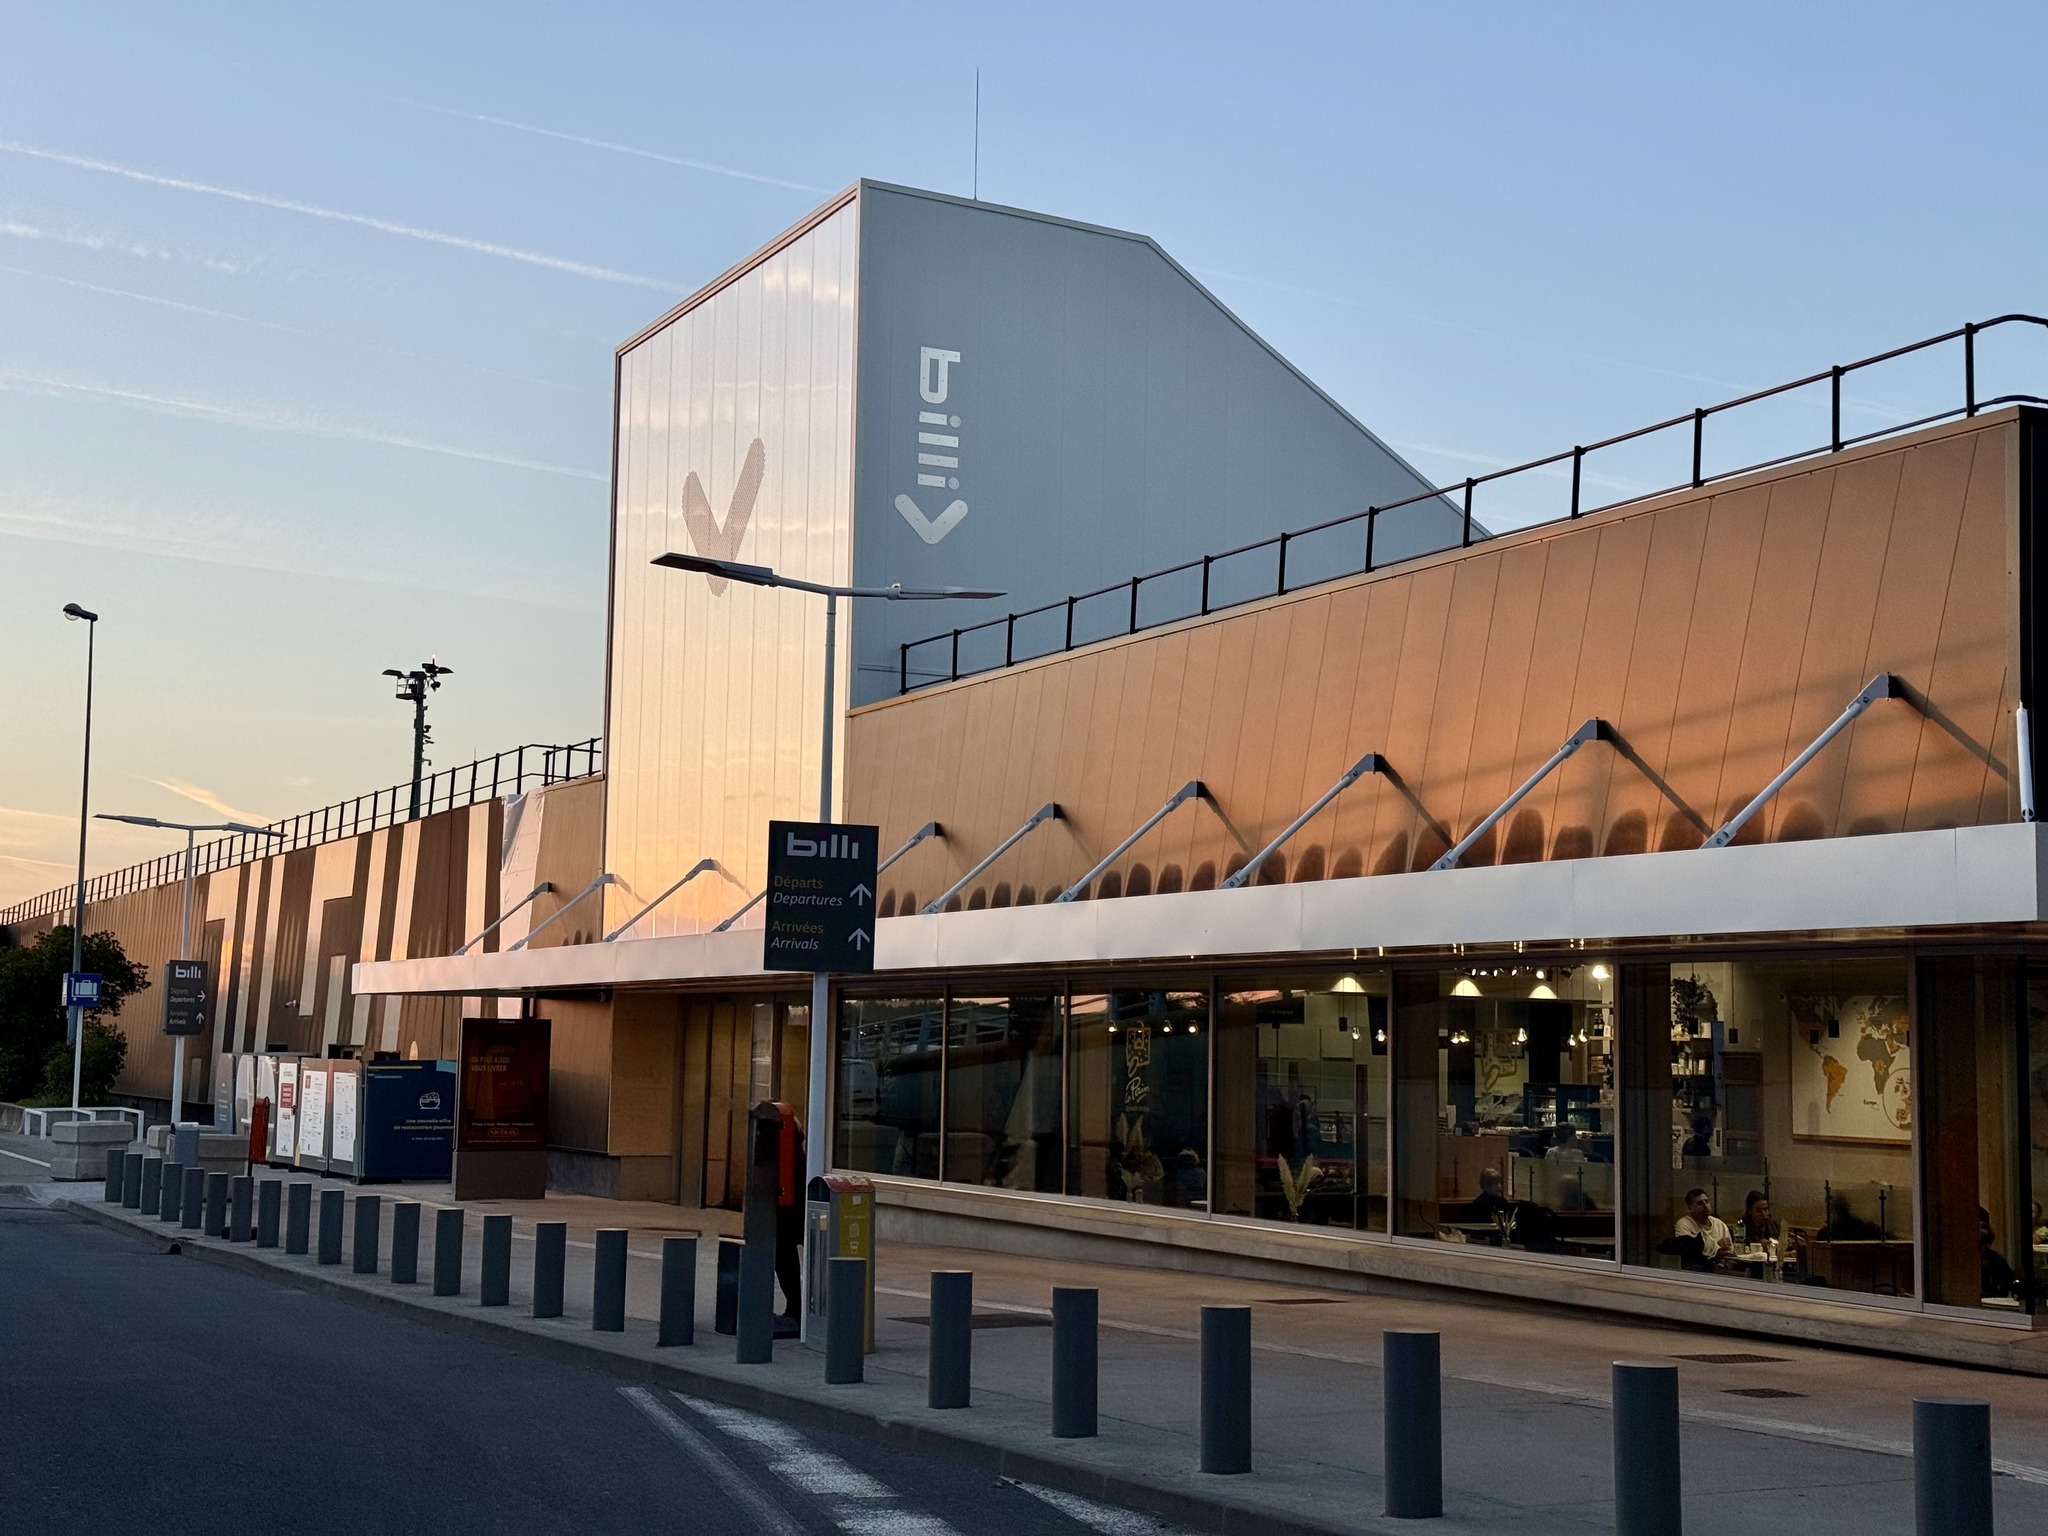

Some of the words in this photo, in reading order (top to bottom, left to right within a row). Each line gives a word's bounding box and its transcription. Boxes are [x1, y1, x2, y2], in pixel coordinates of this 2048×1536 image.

[917, 346, 962, 490] billi
[787, 831, 859, 860] billi
[774, 875, 824, 889] Départs
[773, 892, 843, 907] Departures
[772, 920, 824, 934] Arrivées
[770, 937, 819, 950] Arrivals
[175, 965, 201, 979] billi
[1126, 1077, 1150, 1102] Pain
